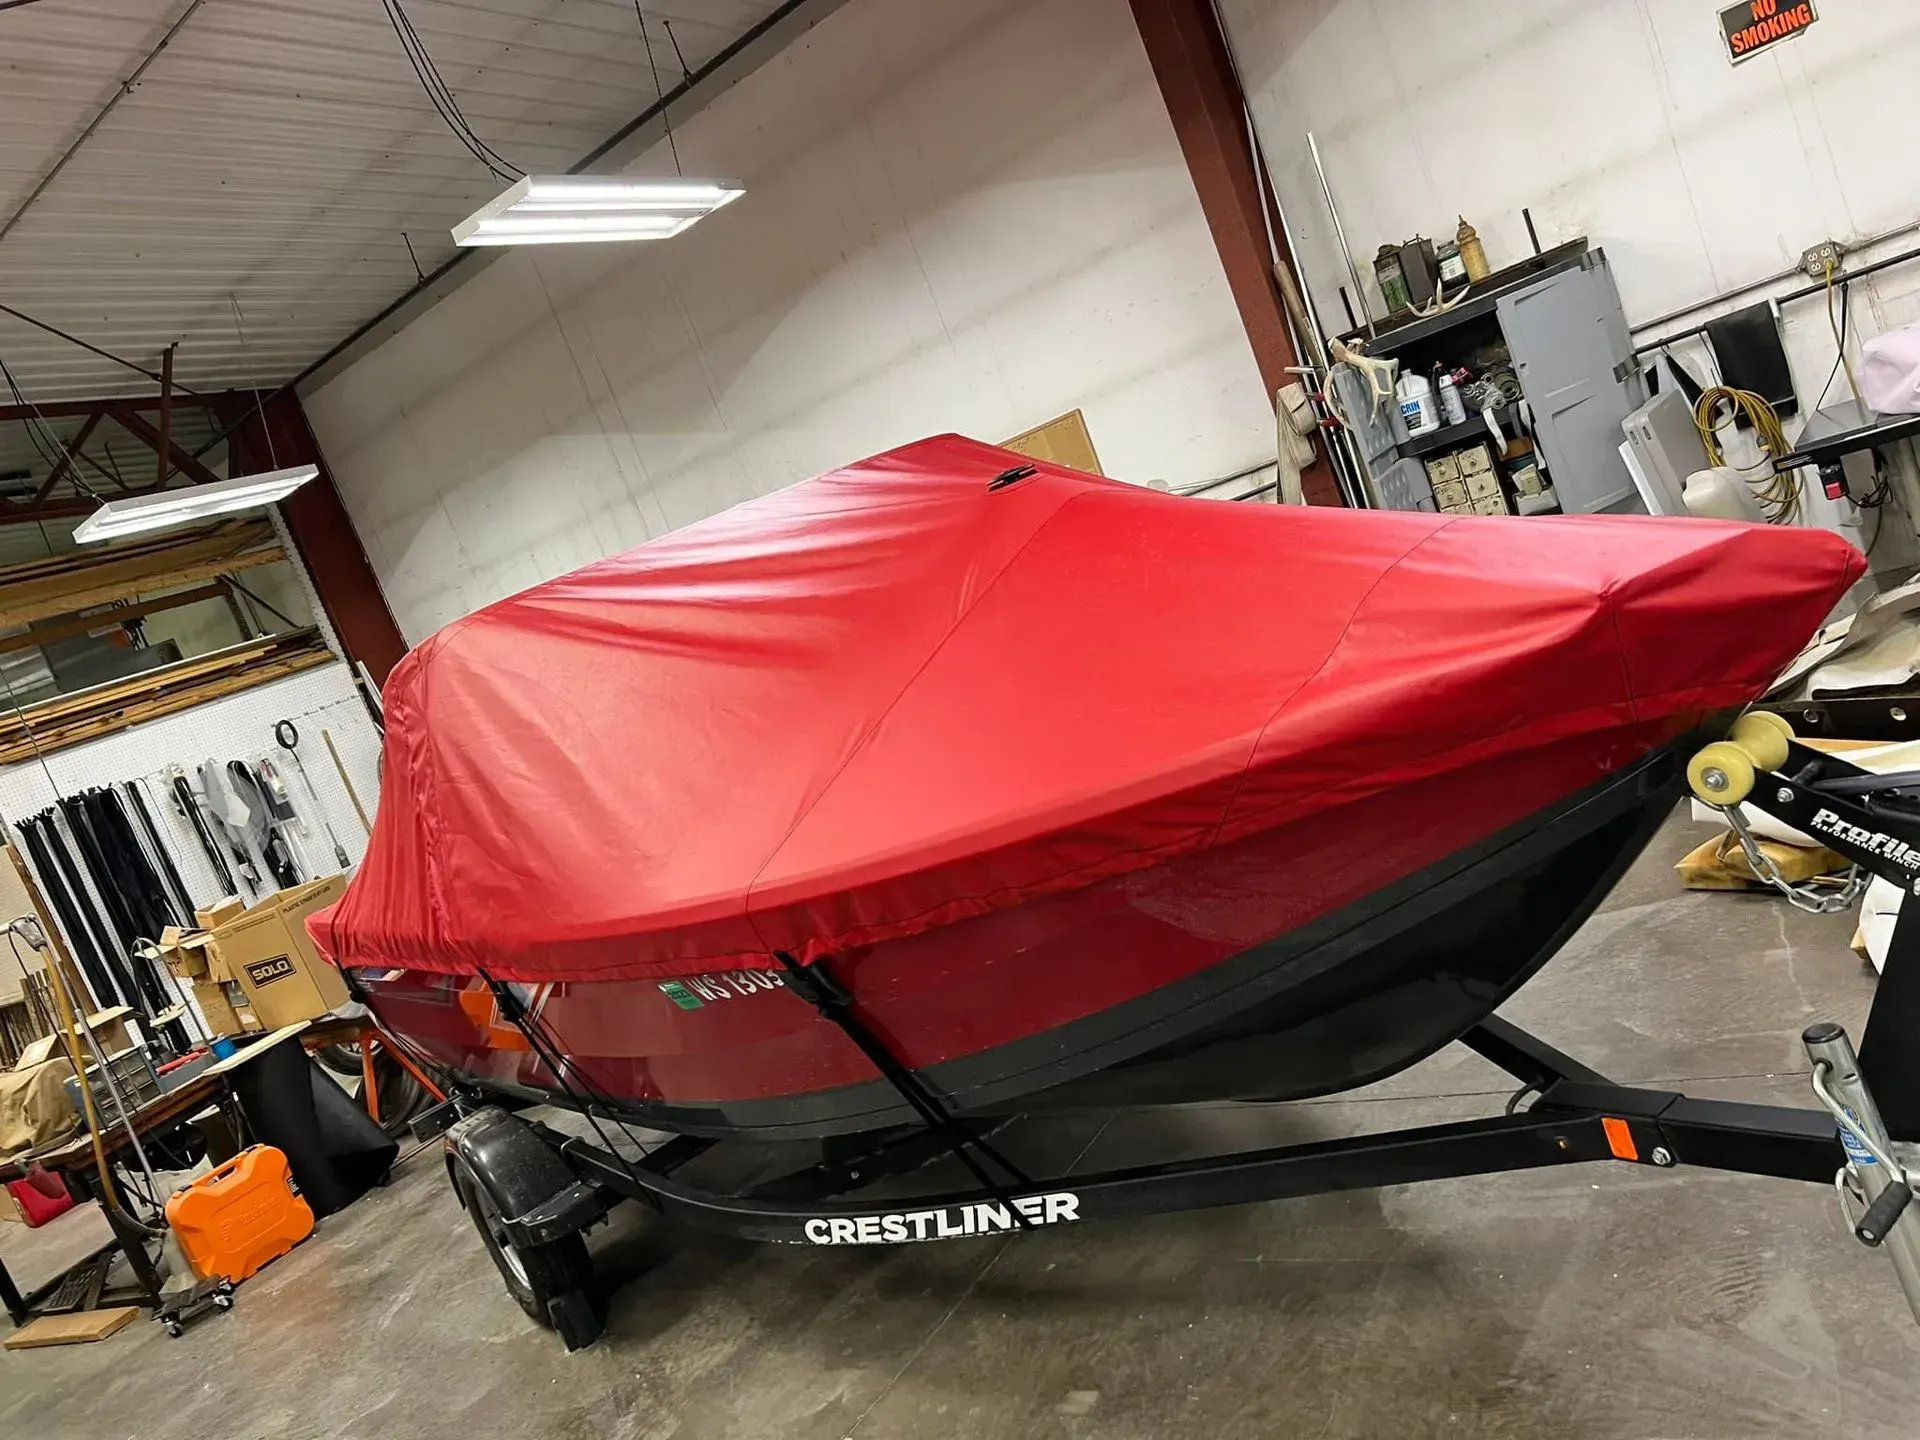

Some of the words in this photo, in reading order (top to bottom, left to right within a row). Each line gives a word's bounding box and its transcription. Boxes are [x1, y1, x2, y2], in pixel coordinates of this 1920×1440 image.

[1731, 4, 1811, 53] SMOKING
[1751, 0, 1777, 21] NO
[1810, 821, 1881, 855] PERFORMANCE
[1812, 808, 1920, 867] Profile
[252, 960, 288, 980] SOLO
[804, 1192, 1080, 1245] CRESTLINER
